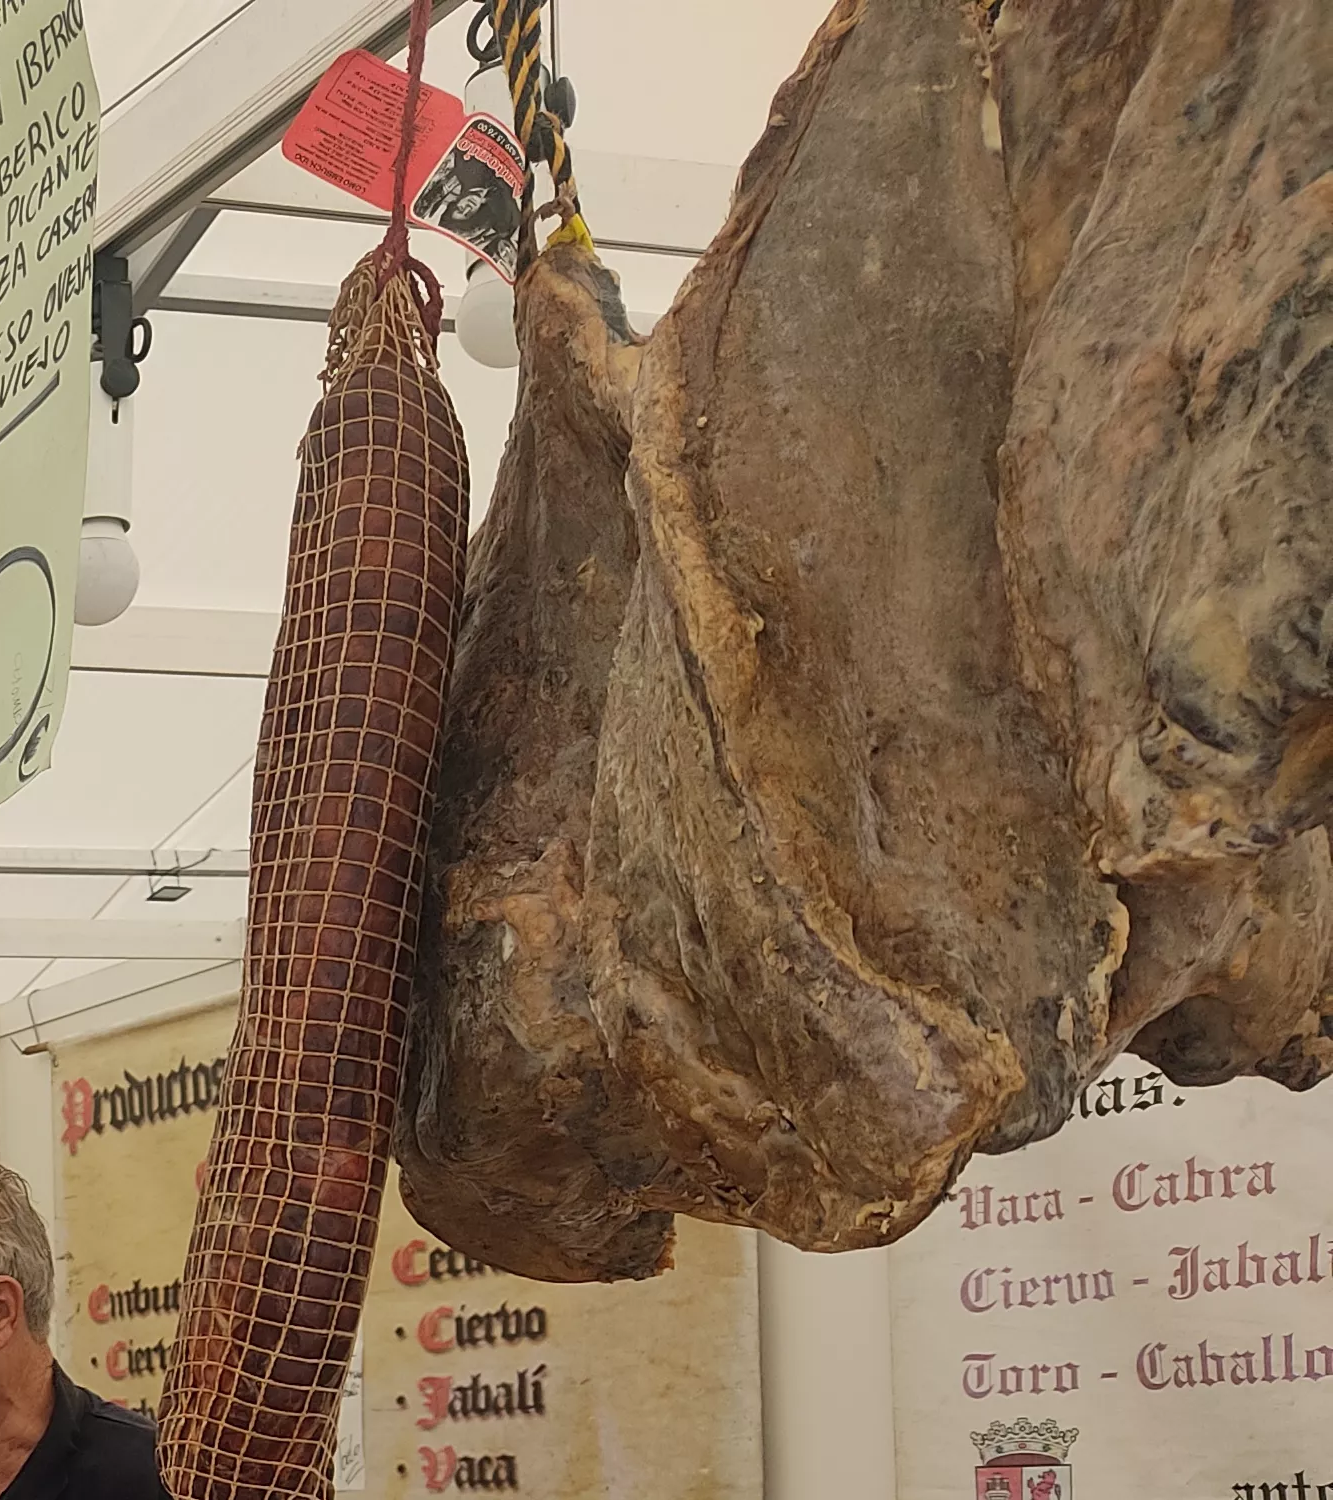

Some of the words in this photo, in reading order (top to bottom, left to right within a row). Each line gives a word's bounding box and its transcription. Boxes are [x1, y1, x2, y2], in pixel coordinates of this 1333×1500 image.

[7, 121, 97, 242] PICANTE
[0, 320, 70, 408] VIEJO
[959, 1184, 1065, 1231] Vaca
[1112, 1155, 1277, 1213] Cabra
[960, 1267, 1115, 1314] Ciervo
[417, 1300, 547, 1354] Ciervo
[416, 1364, 549, 1430] Jabalí
[961, 1353, 1081, 1400] Toro
[418, 1444, 519, 1494] Vaca
